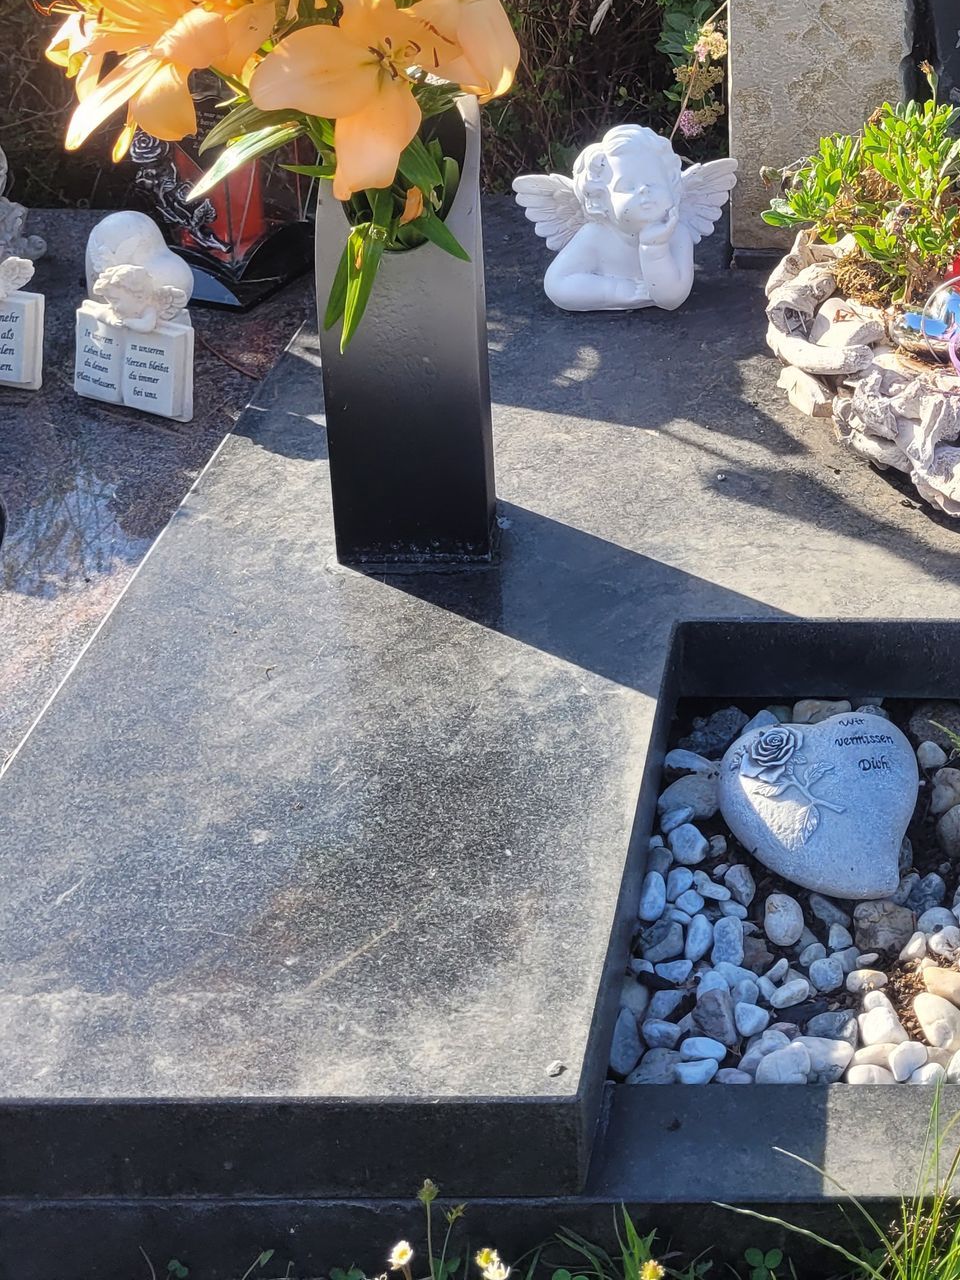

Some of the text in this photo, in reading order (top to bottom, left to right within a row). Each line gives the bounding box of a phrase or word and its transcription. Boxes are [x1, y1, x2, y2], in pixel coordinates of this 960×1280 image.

[0, 328, 15, 340] als
[0, 343, 15, 356] len
[834, 733, 894, 747] vermissen
[858, 755, 889, 771] Dich
